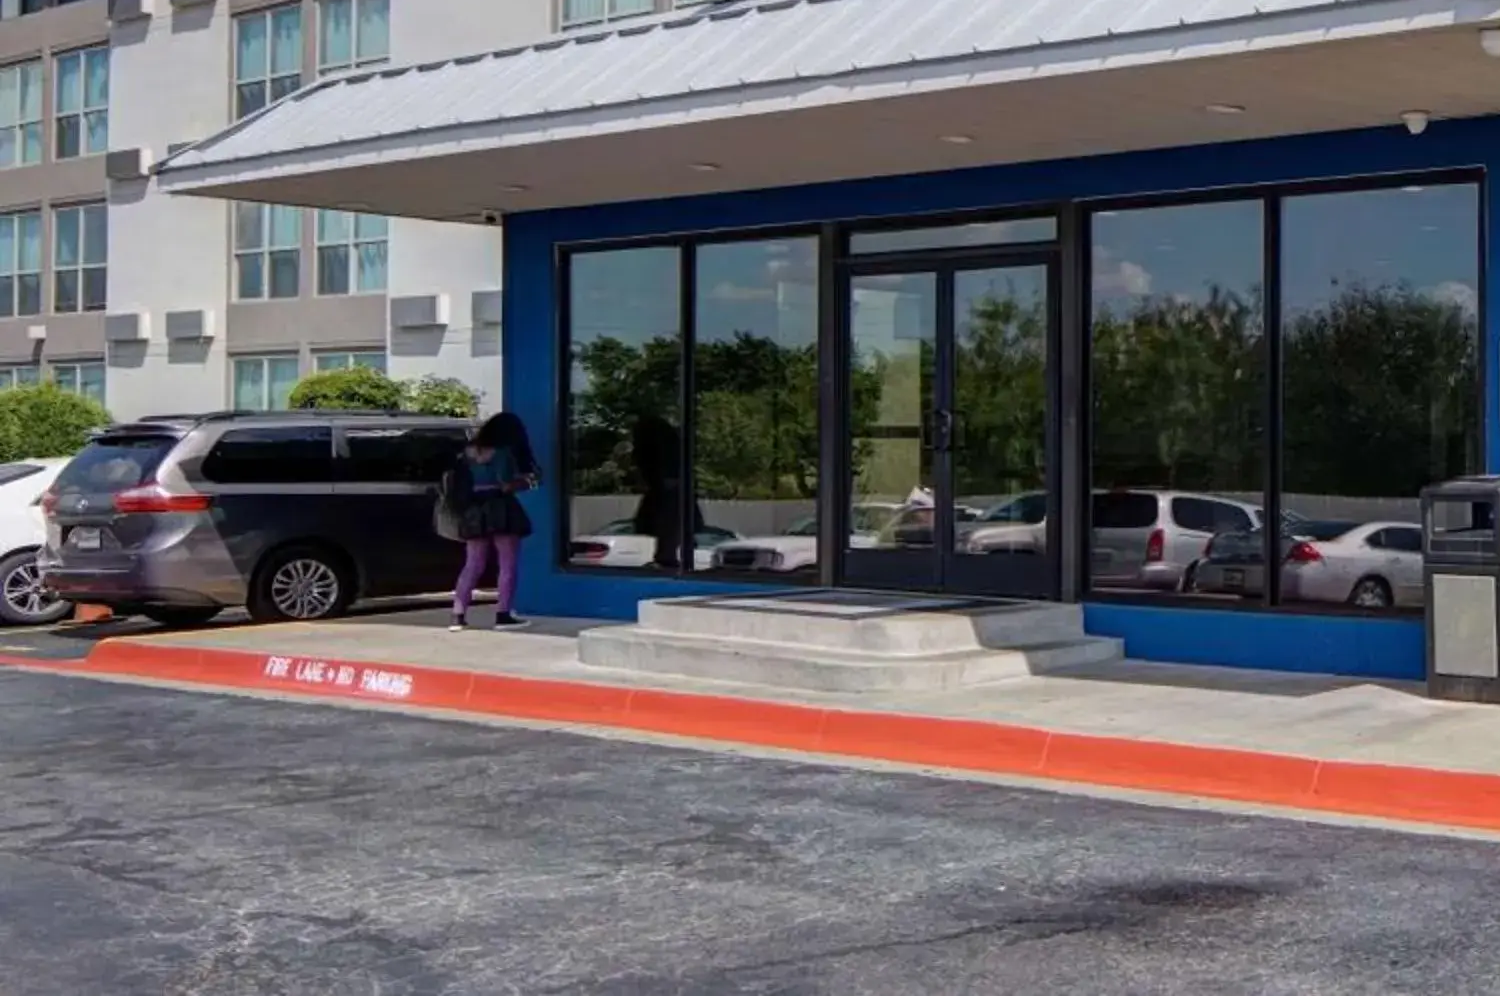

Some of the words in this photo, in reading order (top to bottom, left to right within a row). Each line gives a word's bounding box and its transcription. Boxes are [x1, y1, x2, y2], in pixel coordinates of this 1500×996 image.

[264, 655, 292, 678] FIRE
[295, 659, 328, 684] LANE
[335, 664, 356, 686] NO
[360, 668, 414, 698] PARKING
